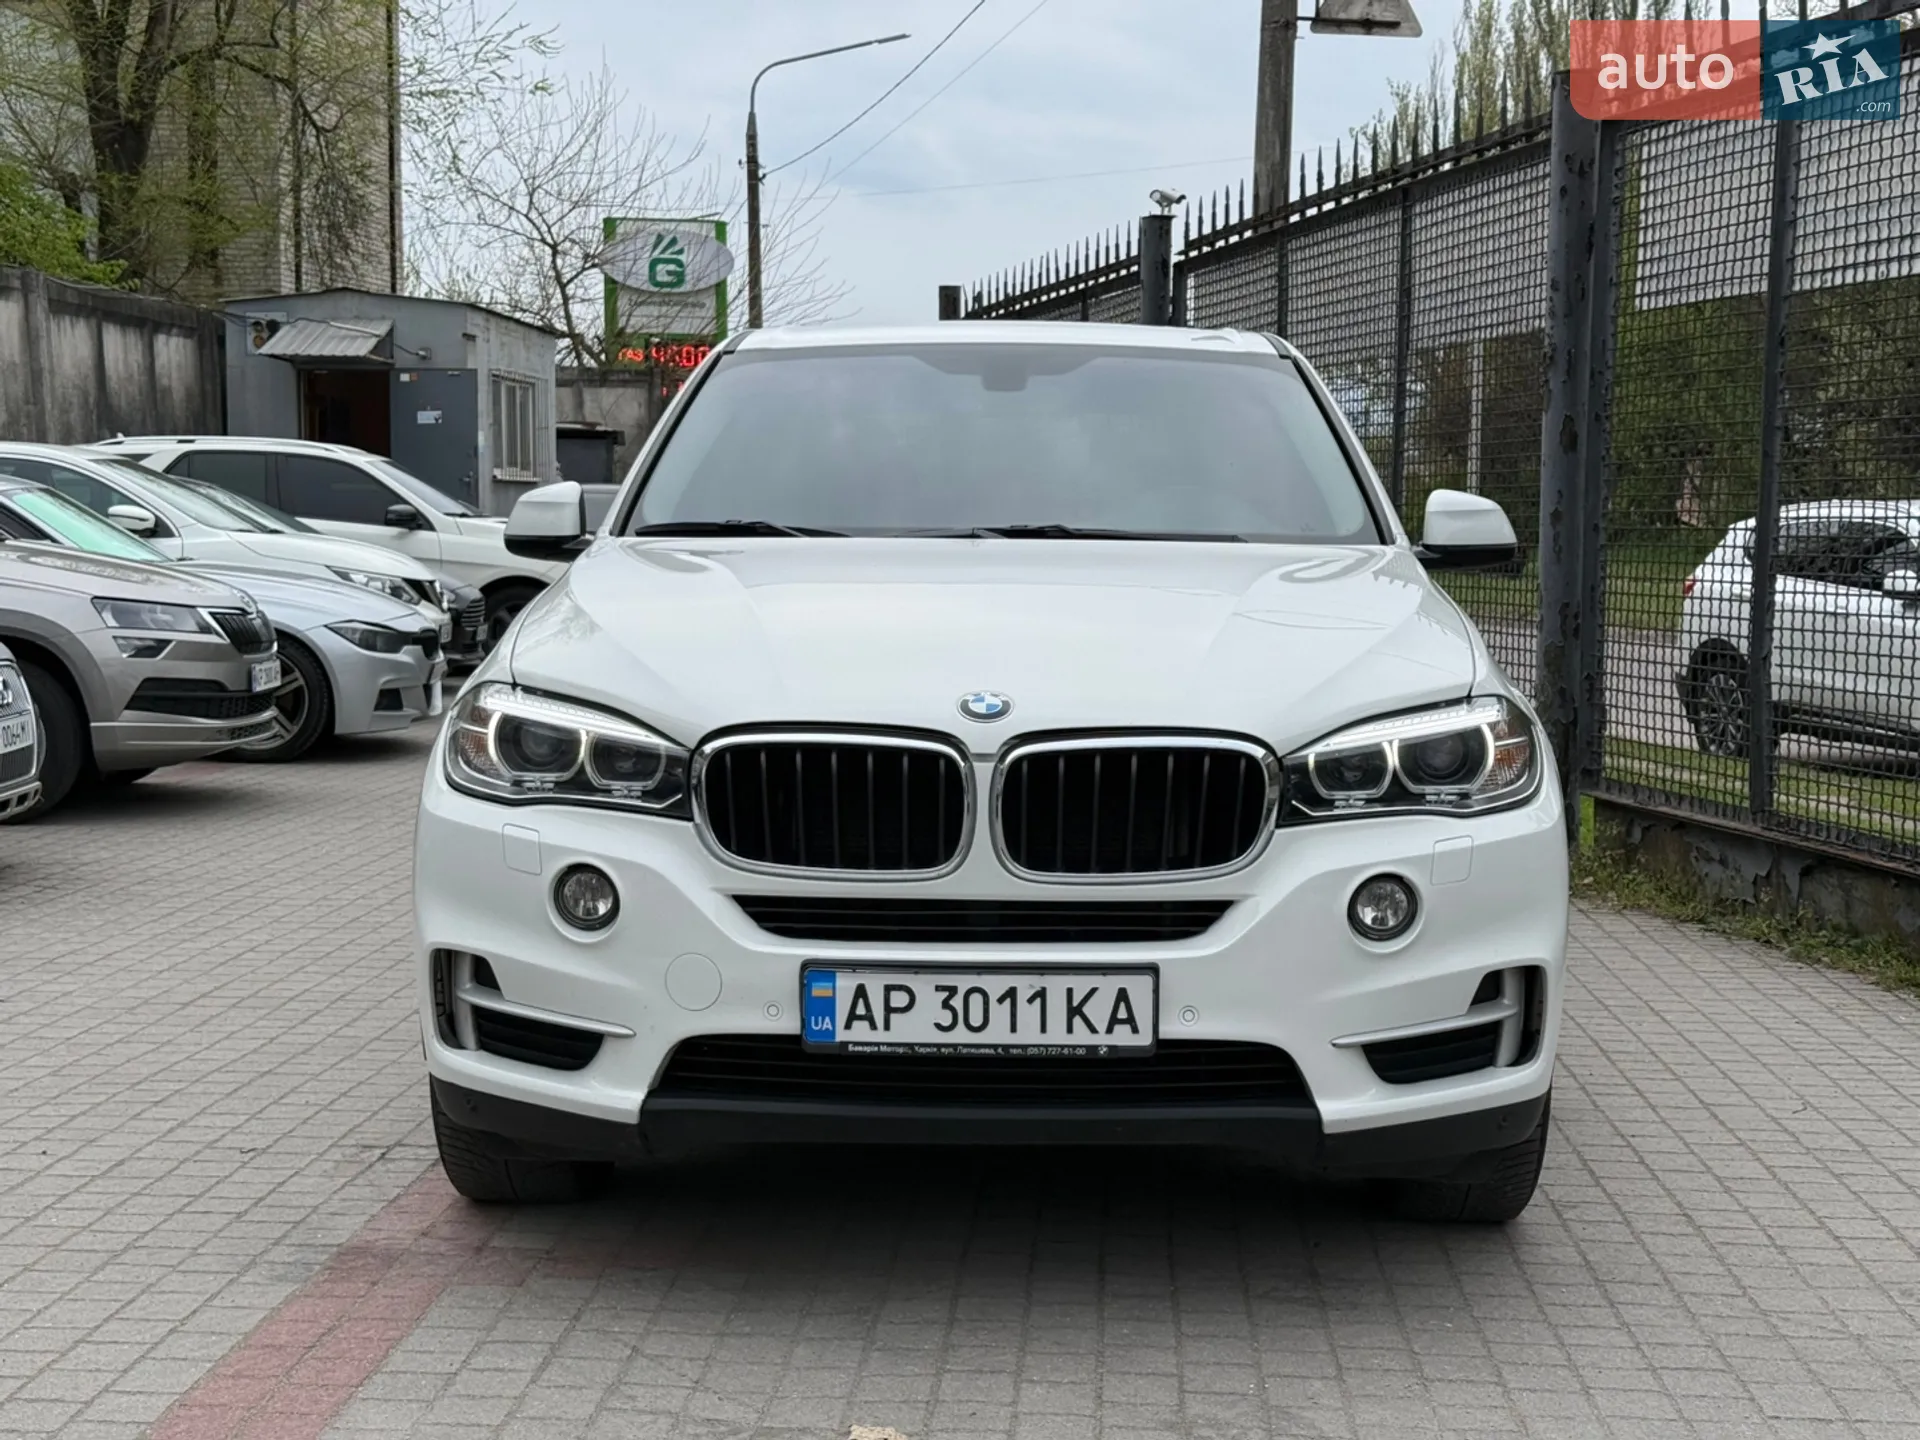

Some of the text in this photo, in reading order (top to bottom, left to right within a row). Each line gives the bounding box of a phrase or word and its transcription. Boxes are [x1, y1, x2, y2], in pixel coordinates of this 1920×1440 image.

[811, 1016, 832, 1030] UA
[843, 982, 1140, 1035] AP 3011 KA
